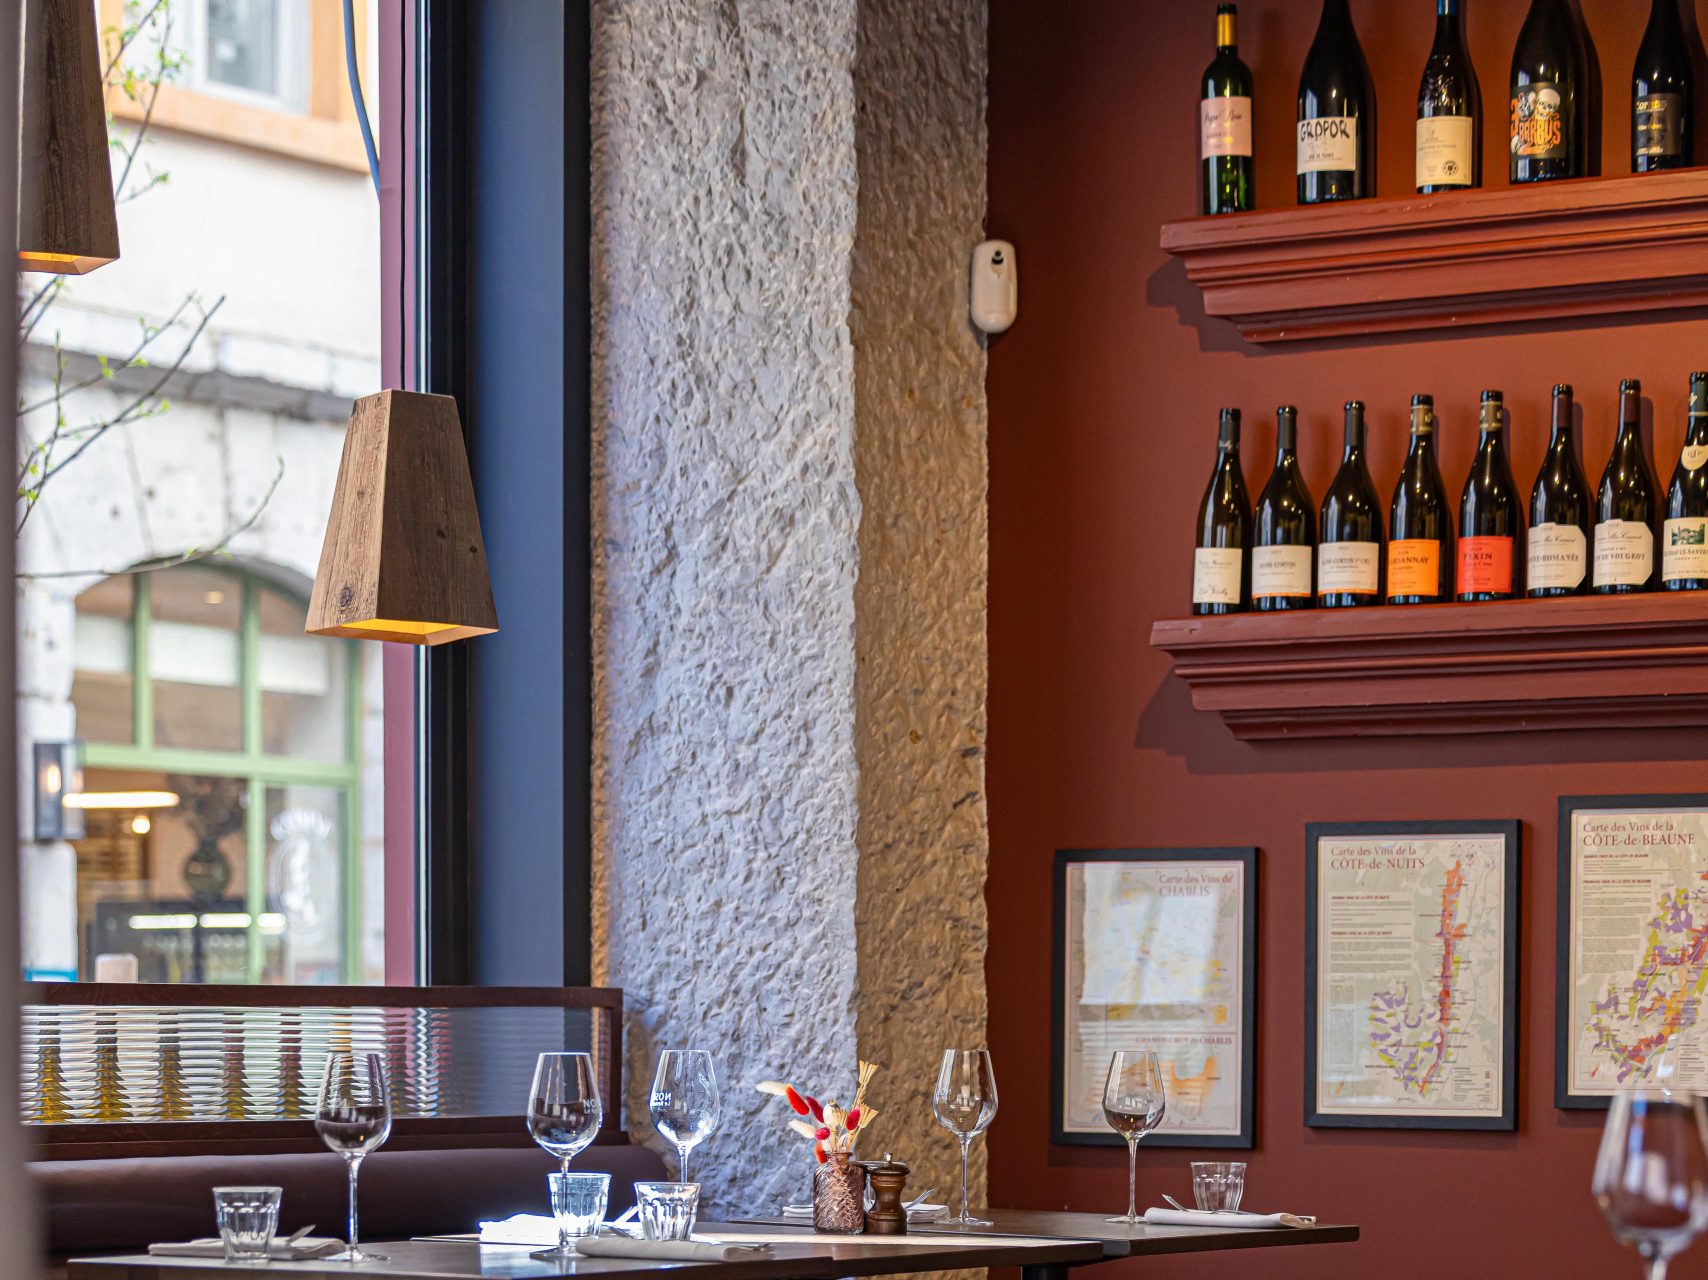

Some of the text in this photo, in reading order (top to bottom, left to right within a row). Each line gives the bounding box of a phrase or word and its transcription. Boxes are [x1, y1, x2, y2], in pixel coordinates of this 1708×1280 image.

[1300, 118, 1350, 142] GROPOR
[1518, 119, 1562, 149] BARBUS
[1463, 552, 1493, 561] FIXIN
[1582, 821, 1675, 833] Carte des Vins de la
[1583, 833, 1696, 847] CÔTE-de-BEAUNE
[1330, 845, 1416, 857] Carte des Vins de la
[1331, 857, 1425, 870] CÔTE-de-NUITS
[1159, 871, 1234, 884] Carte des Vins de
[1159, 885, 1211, 897] CHABLIS
